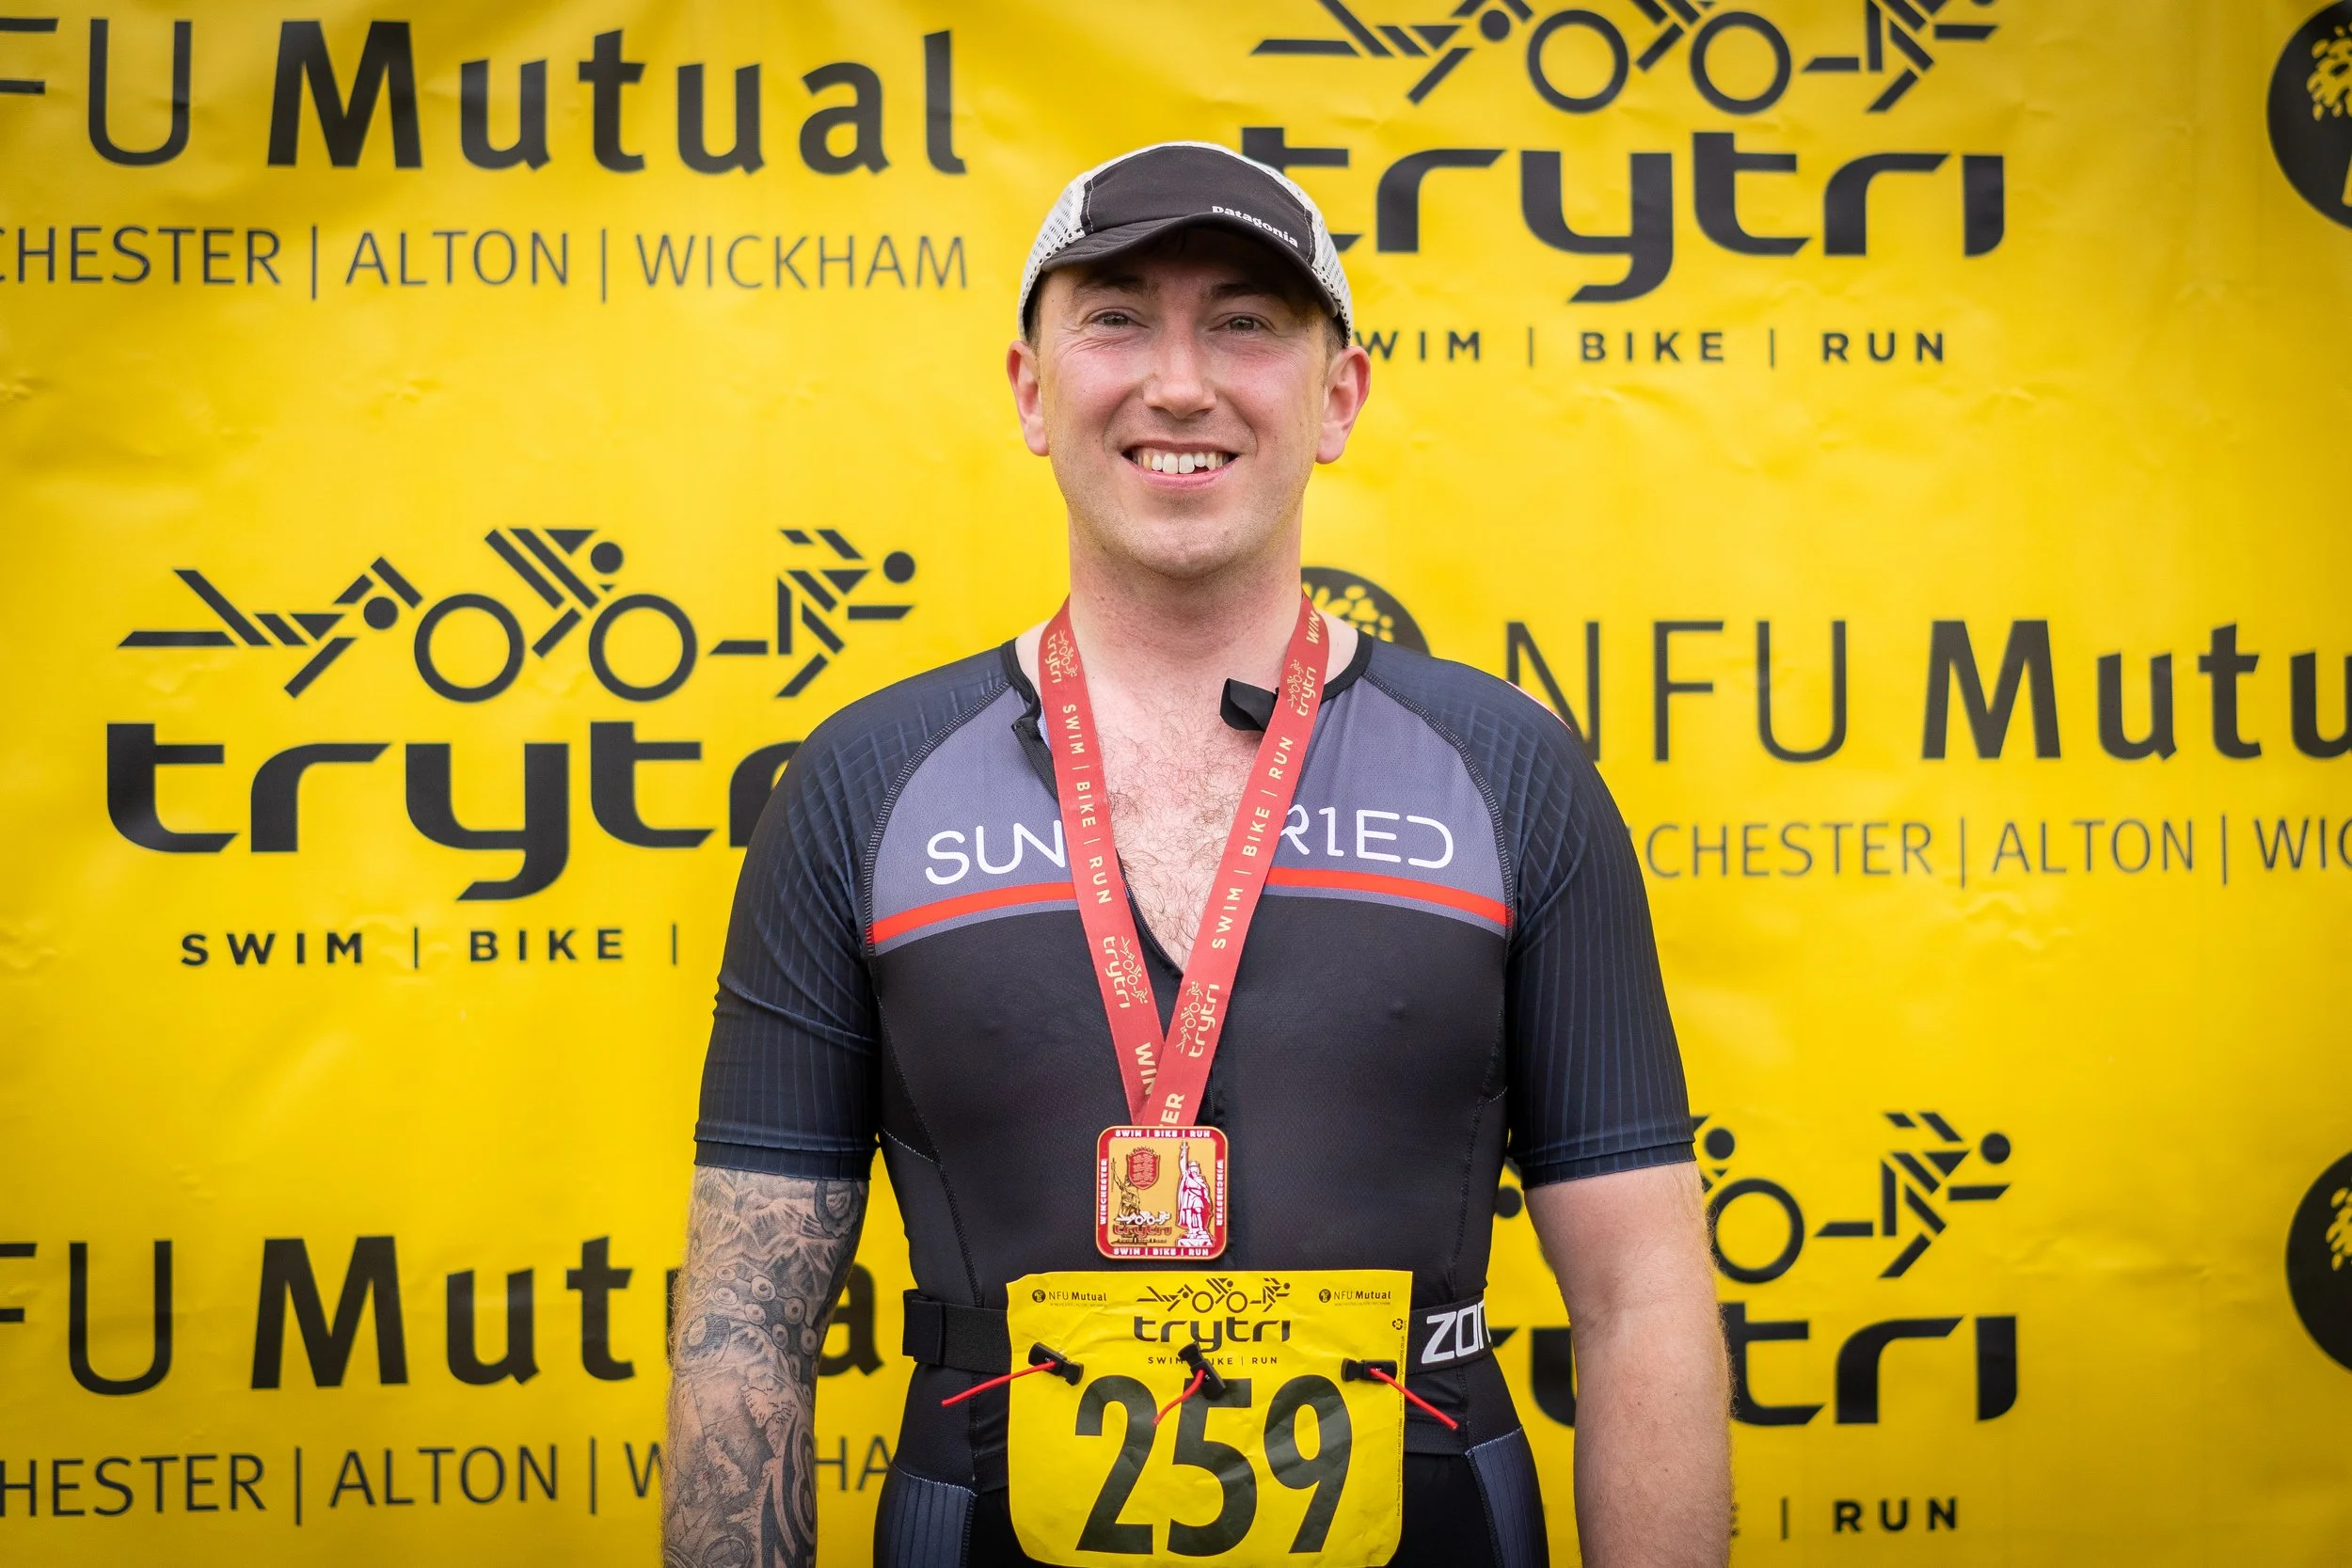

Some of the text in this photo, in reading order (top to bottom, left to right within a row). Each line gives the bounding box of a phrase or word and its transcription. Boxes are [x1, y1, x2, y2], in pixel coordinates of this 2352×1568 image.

[266, 19, 967, 175] Mutual
[1212, 205, 1298, 248] patagonia
[0, 226, 967, 290] HESTER ALTON WICKHAM
[1354, 330, 1945, 362] WIM BIKE RUN
[1295, 666, 1317, 717] trytri
[1507, 619, 2352, 764] NFU Mutu
[107, 721, 803, 902] trytr
[1062, 704, 1112, 905] SWIM BIKE RUN
[1211, 736, 1295, 950] SWIM BIKE RUN
[1626, 822, 1932, 879] CHESTER
[1993, 818, 2195, 874] ALTON
[181, 928, 624, 967] SWIM BIKE
[1103, 935, 1131, 1009] trytri
[1187, 983, 1220, 1058] trytri
[1154, 1130, 1178, 1138] BIKE
[1189, 1130, 1211, 1138] RUN
[1152, 1247, 1177, 1257] BIKE
[1188, 1247, 1209, 1257] RUN
[1048, 1291, 1107, 1302] NFU Mutual
[1333, 1290, 1391, 1300] NFU Mutual
[1134, 1316, 1291, 1354] trytri
[1251, 1356, 1278, 1365] RUN
[329, 1445, 557, 1509] ALTON
[1074, 1373, 1353, 1557] 259
[1834, 1497, 1958, 1534] RUN
